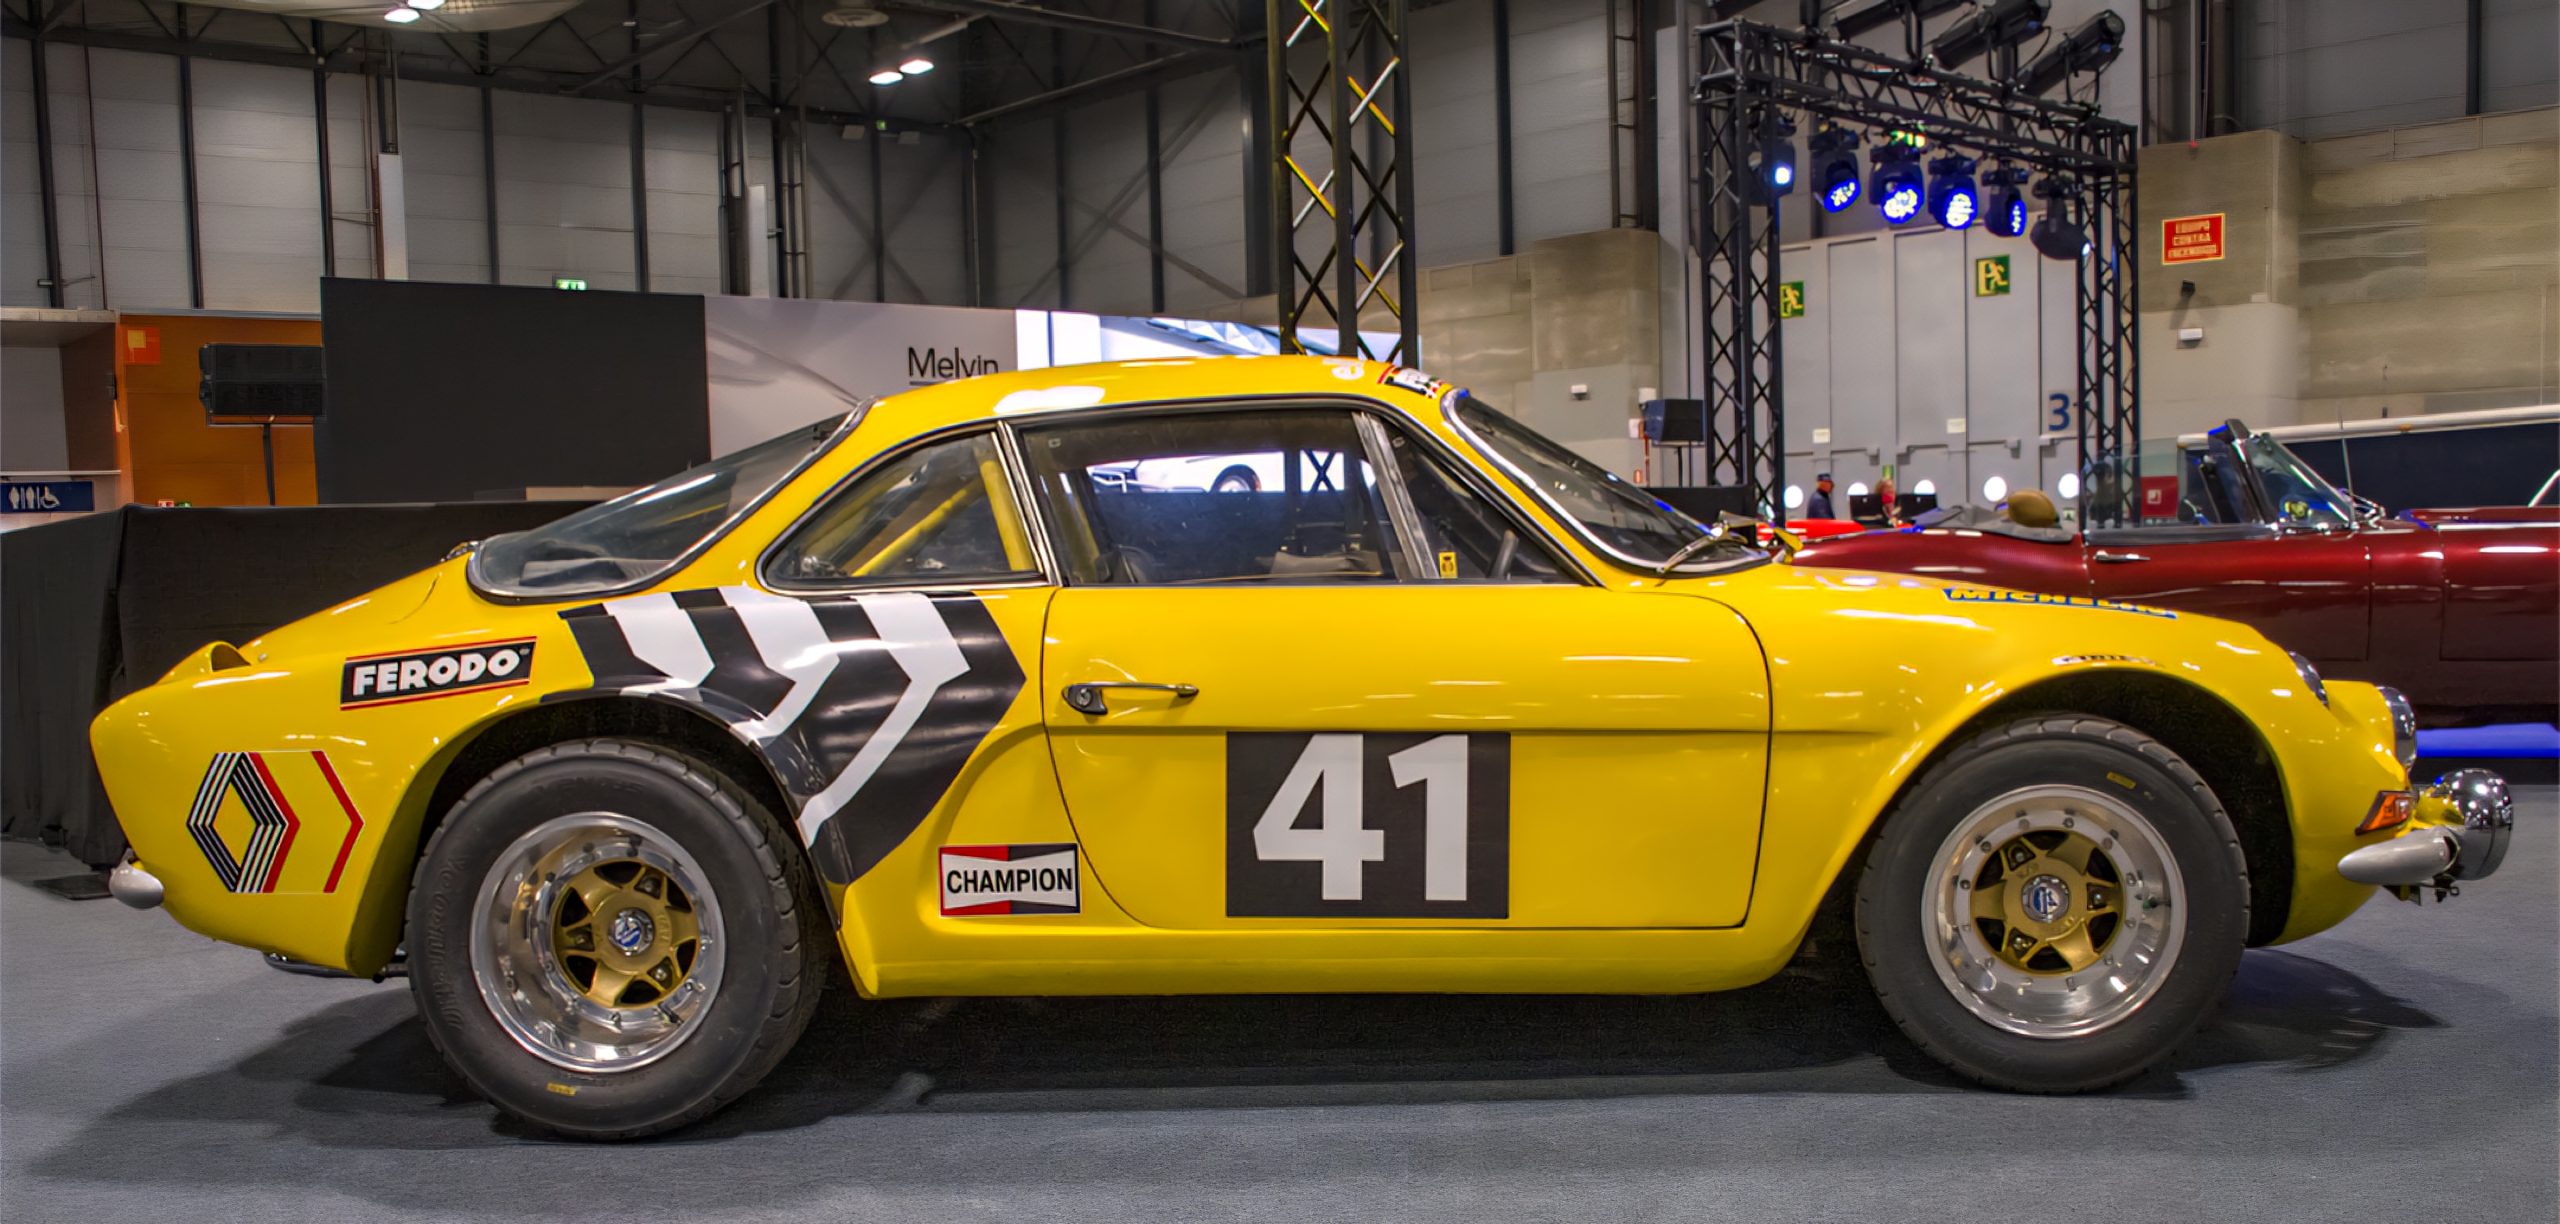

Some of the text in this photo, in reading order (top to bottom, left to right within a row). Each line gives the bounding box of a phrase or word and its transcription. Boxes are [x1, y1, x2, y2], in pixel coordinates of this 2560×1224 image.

[908, 346, 999, 379] Melvin
[2048, 393, 2071, 432] 3
[353, 649, 520, 696] FERODO
[1253, 734, 1468, 901] 41
[946, 868, 1073, 894] CHAMPION
